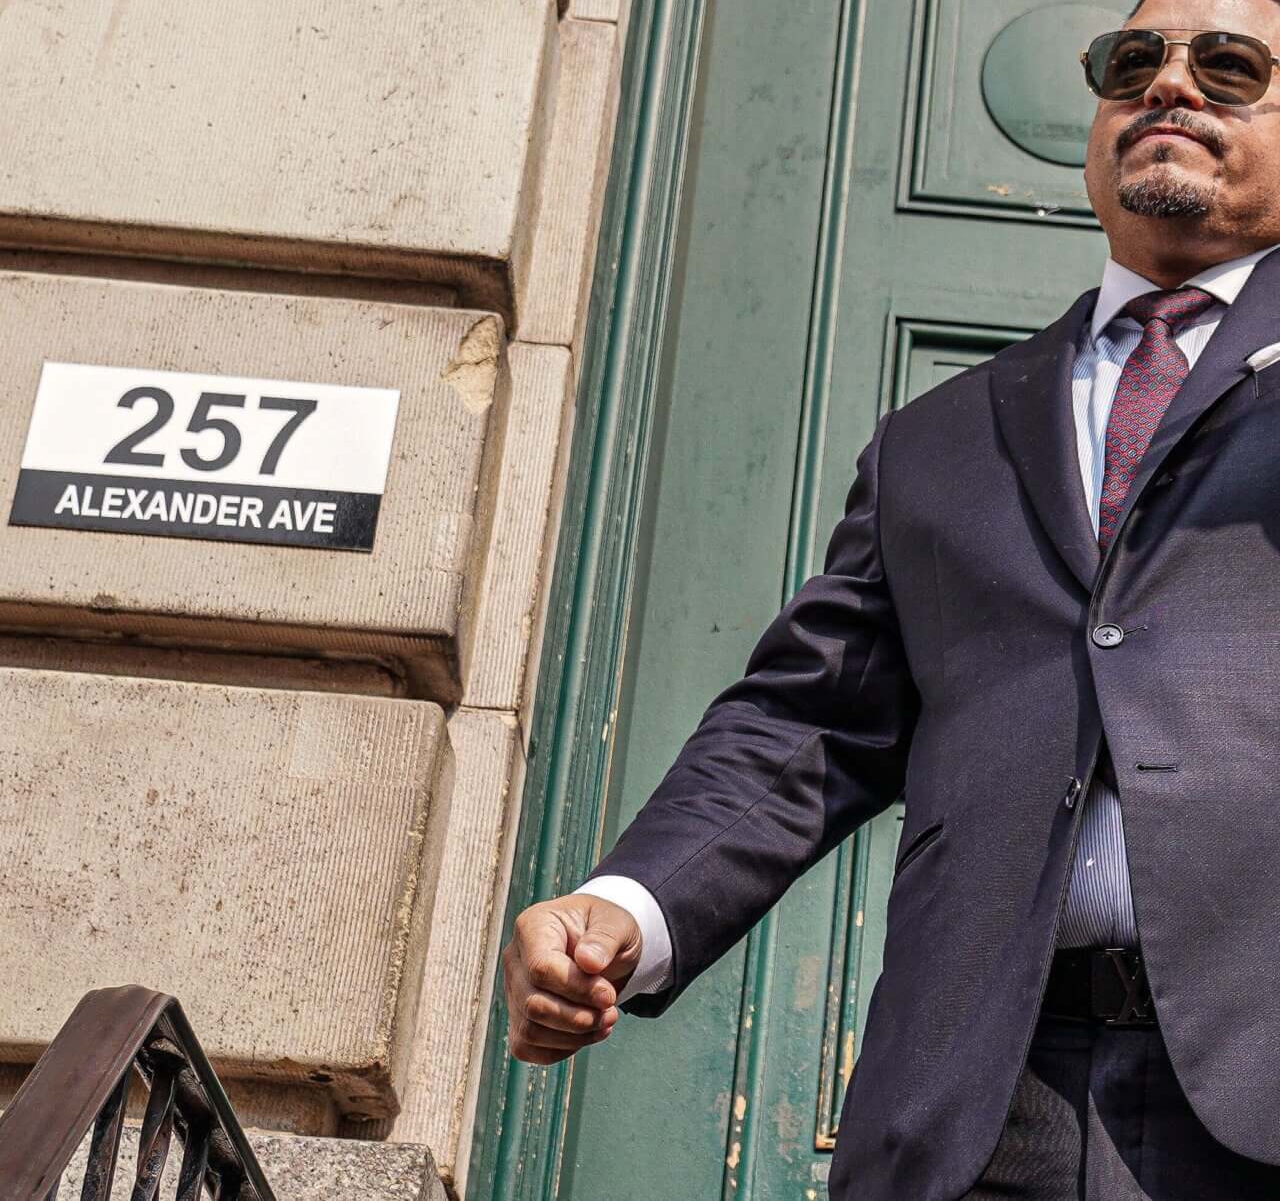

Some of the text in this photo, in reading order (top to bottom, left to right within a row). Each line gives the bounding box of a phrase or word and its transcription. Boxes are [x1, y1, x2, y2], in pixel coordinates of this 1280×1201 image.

[103, 386, 318, 476] 257
[54, 484, 338, 534] ALEXANDER AVE
